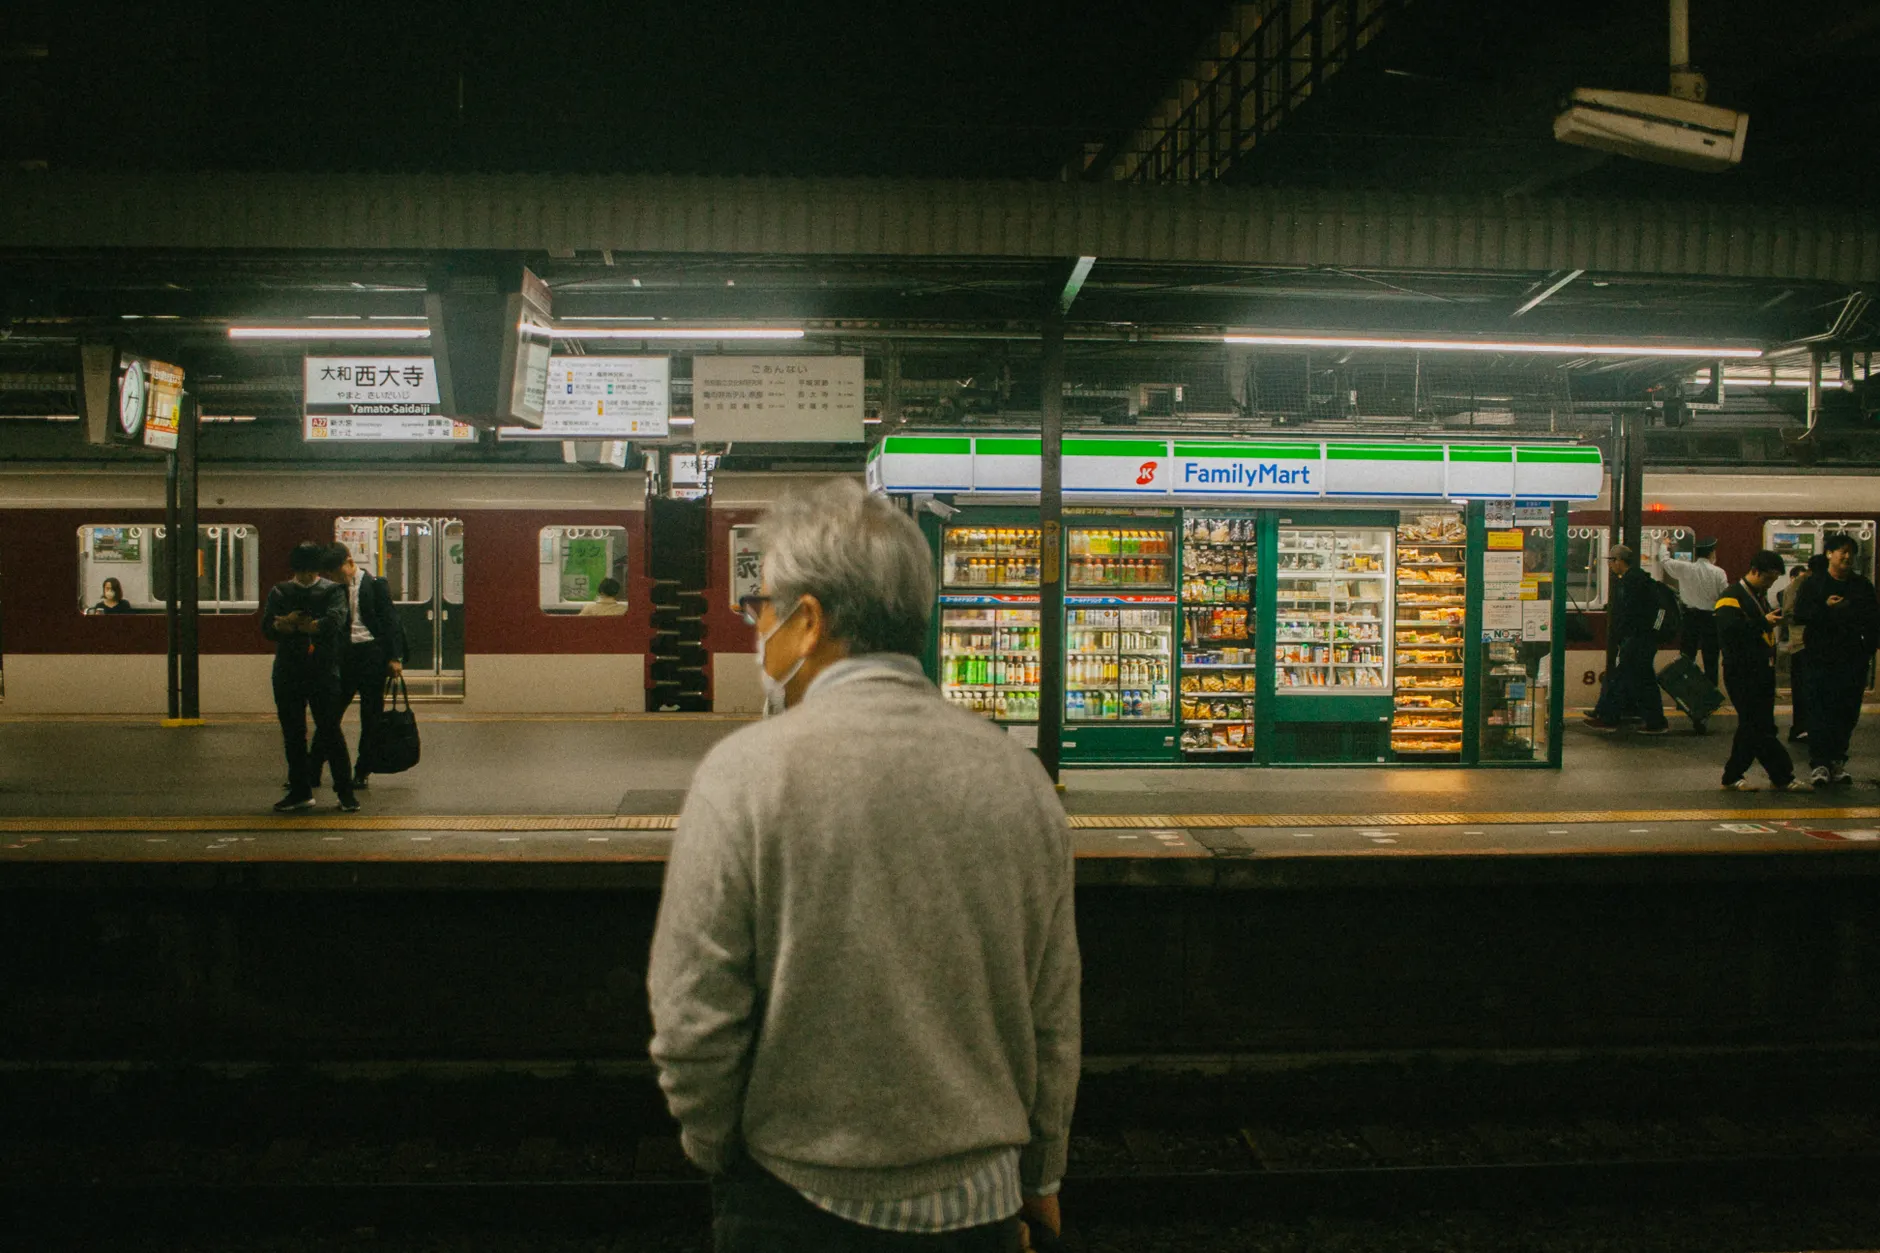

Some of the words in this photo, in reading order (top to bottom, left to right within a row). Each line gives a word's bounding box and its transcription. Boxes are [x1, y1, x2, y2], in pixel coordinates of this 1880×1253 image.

[321, 365, 424, 387] 大和西大寺
[337, 391, 361, 400] やまと
[368, 391, 410, 400] さいだいじ
[350, 404, 431, 415] Yamato-Saidaiji
[1184, 462, 1310, 487] FamilyMart
